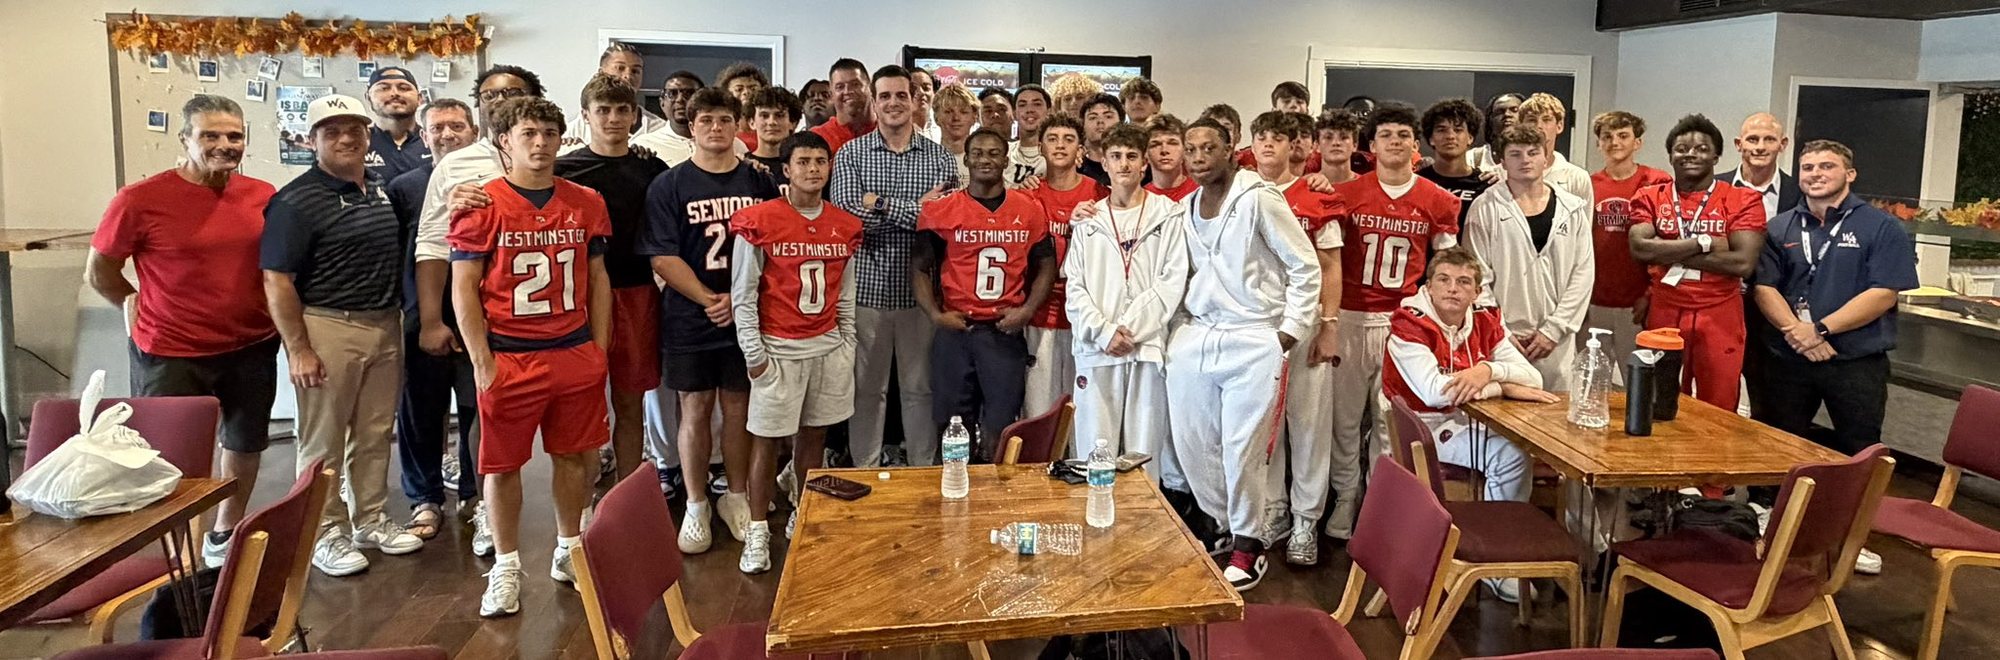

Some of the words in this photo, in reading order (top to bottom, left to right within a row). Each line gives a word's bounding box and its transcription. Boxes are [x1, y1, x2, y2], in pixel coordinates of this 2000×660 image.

[326, 97, 349, 110] WA
[963, 77, 978, 86] ICE
[980, 78, 1005, 87] COLD
[1104, 83, 1122, 91] COL
[705, 222, 731, 270] 2
[772, 242, 848, 257] WESTMINSTER
[1362, 233, 1411, 288] 10
[513, 248, 575, 316] 21
[798, 260, 825, 314] 0
[975, 246, 1008, 300] 6
